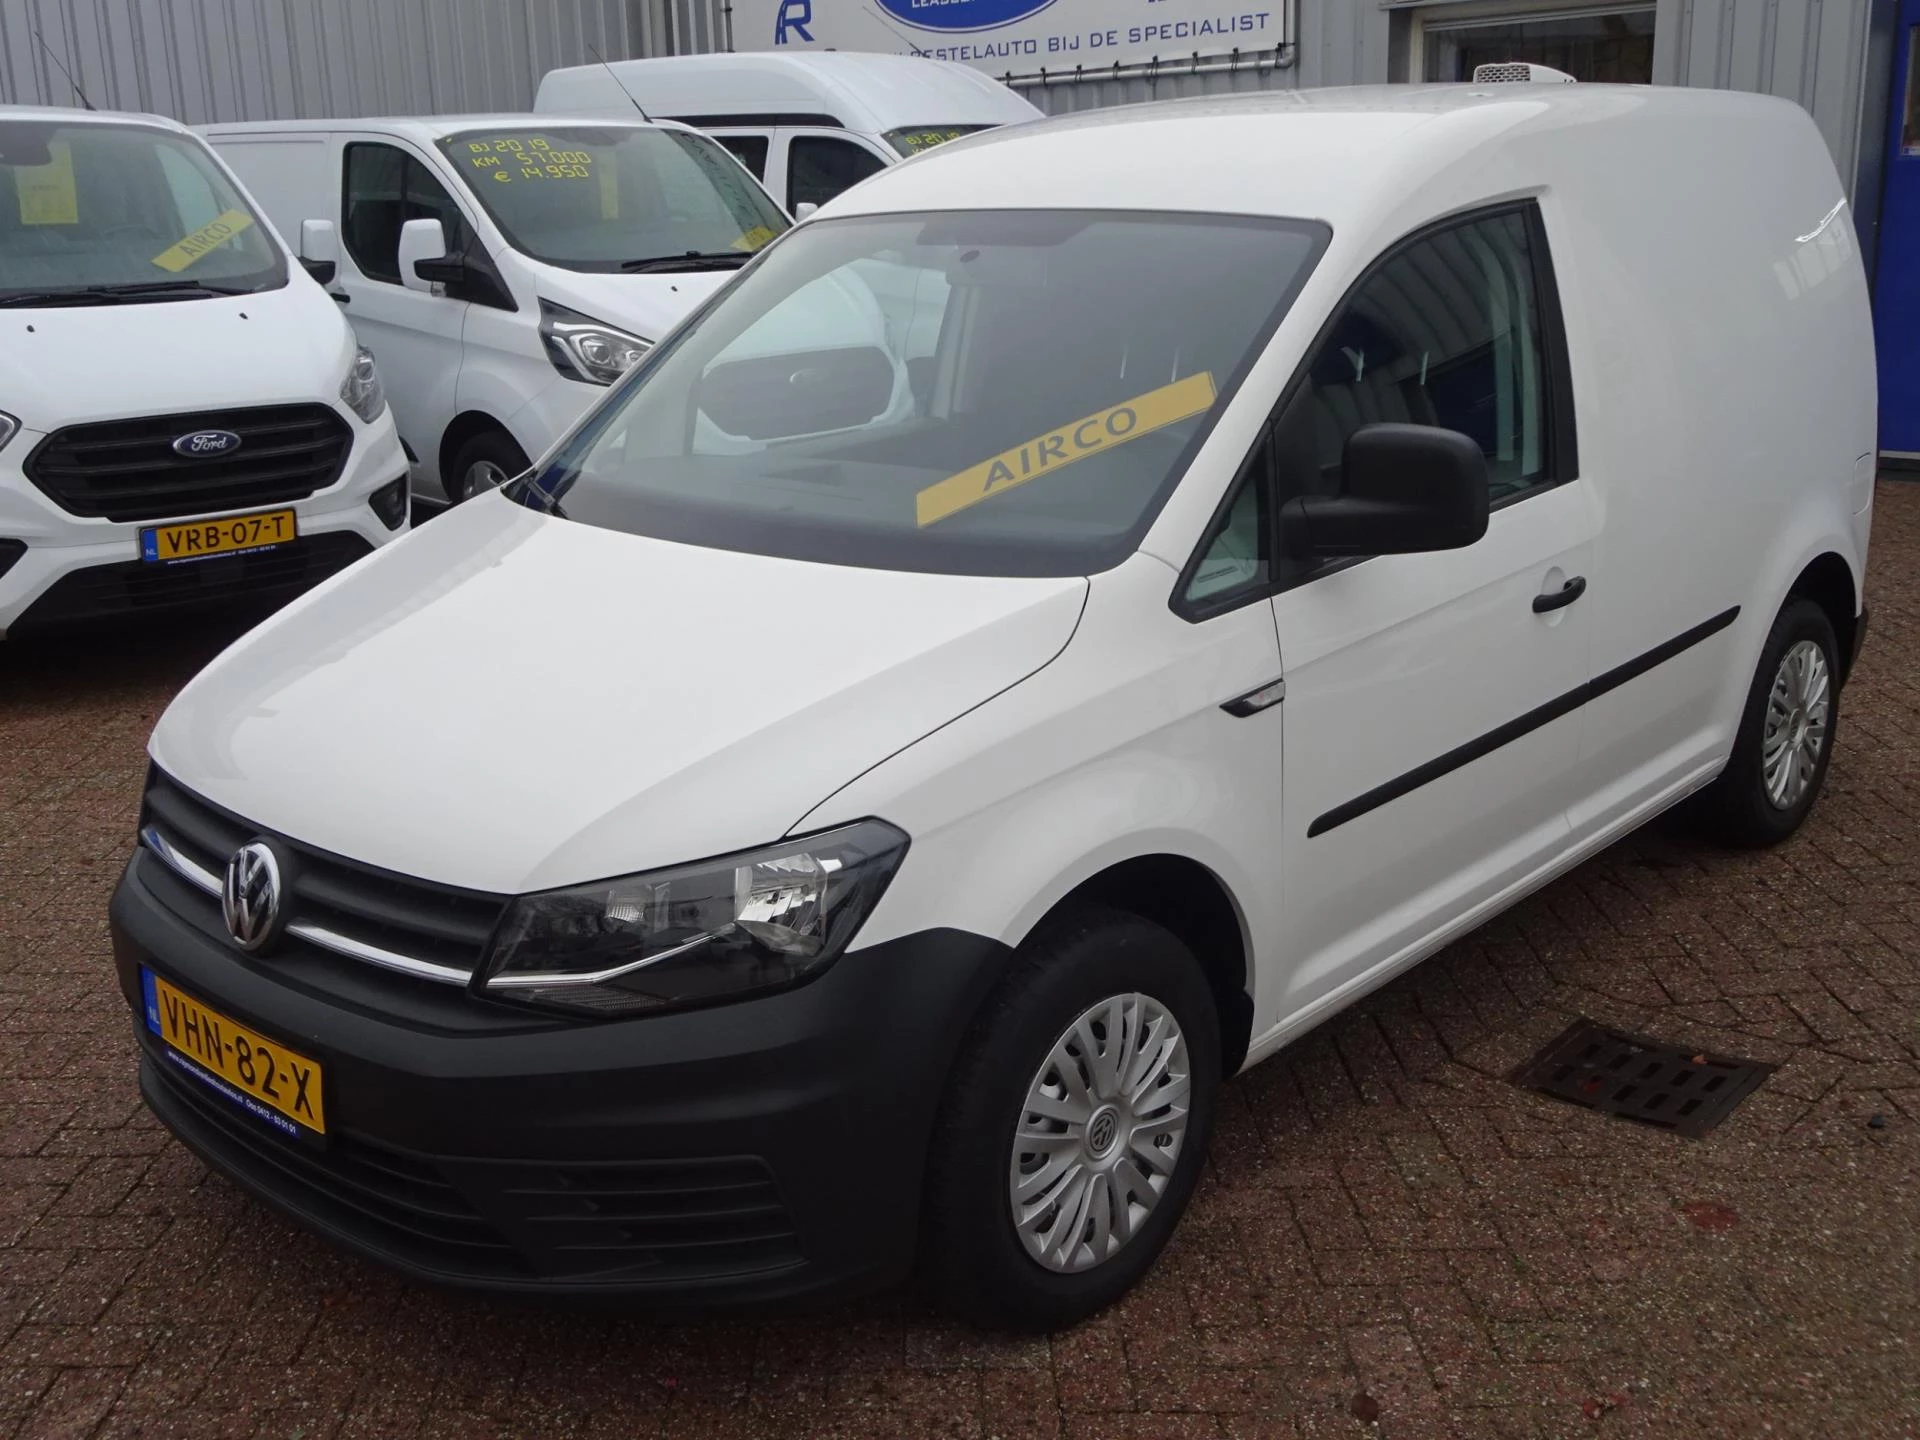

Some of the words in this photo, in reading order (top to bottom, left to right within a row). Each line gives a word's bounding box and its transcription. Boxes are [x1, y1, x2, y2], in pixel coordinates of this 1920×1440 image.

[1048, 36, 1080, 52] BIJ
[1090, 30, 1118, 48] DE
[1129, 13, 1270, 44] SPECIALIST
[471, 156, 501, 168] KM
[516, 151, 592, 165] 57.000
[521, 165, 589, 179] 14.950
[179, 222, 232, 257] AIRCO
[191, 434, 229, 451] Ford
[982, 407, 1137, 492] AIRCO
[145, 548, 157, 557] NL
[166, 515, 286, 553] VRB-07-T
[162, 989, 314, 1121] VHN-82-X
